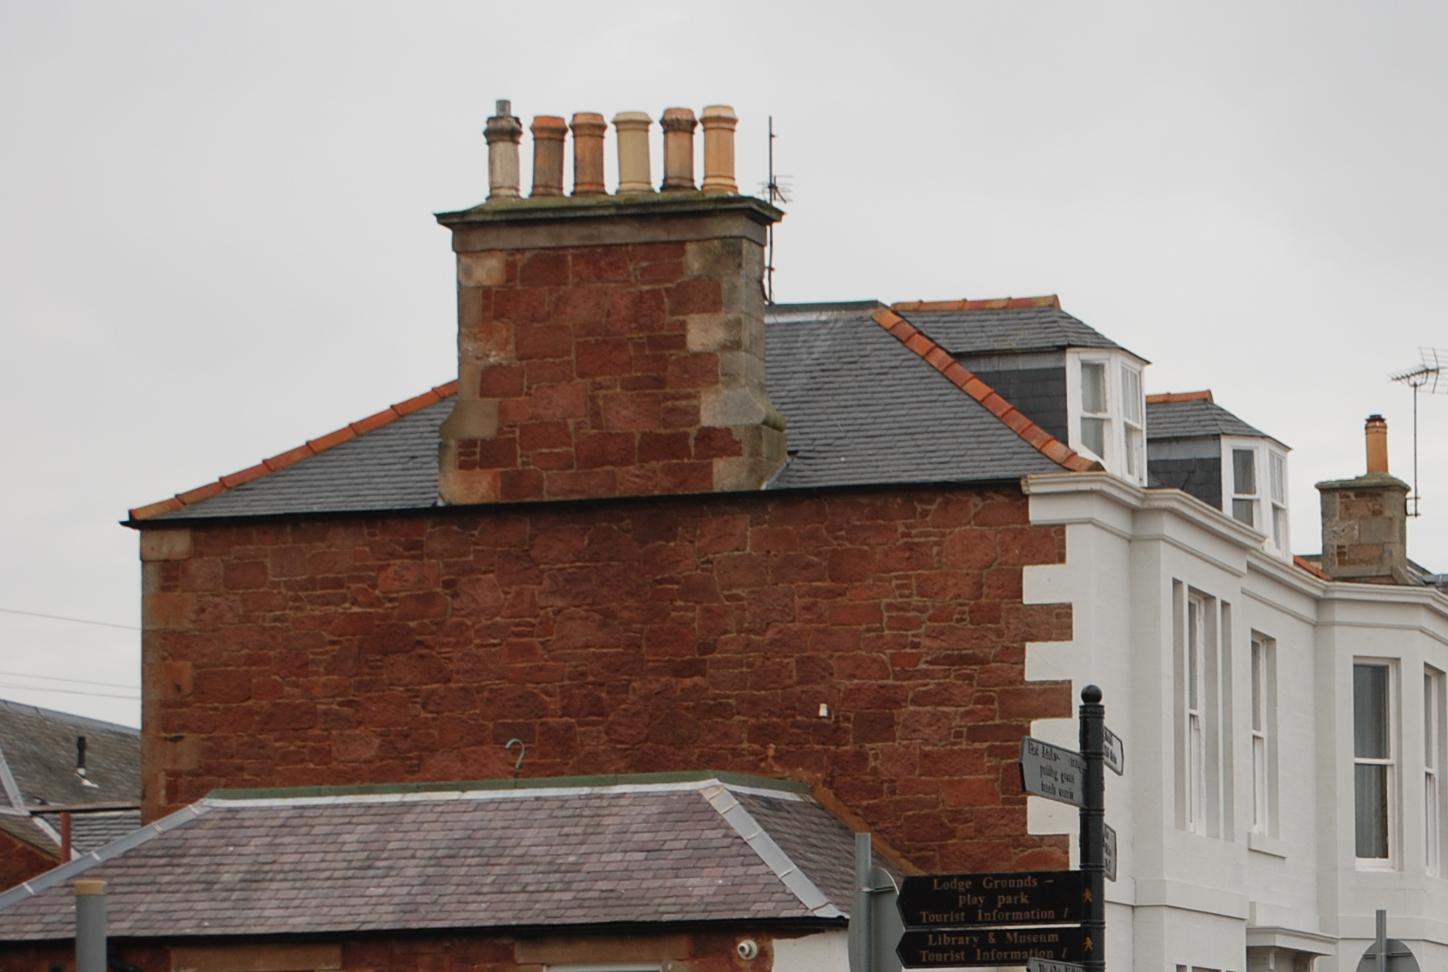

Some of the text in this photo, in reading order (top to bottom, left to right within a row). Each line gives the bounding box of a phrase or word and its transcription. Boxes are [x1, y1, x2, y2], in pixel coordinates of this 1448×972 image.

[933, 878, 972, 892] Lodge
[982, 876, 1038, 889] Grounds
[958, 892, 1029, 907] play park
[920, 911, 965, 922] Tourist
[977, 908, 1055, 921] Information
[928, 932, 1059, 947] Library & Museum
[920, 950, 965, 961] Tourist
[976, 947, 1054, 961] Information
